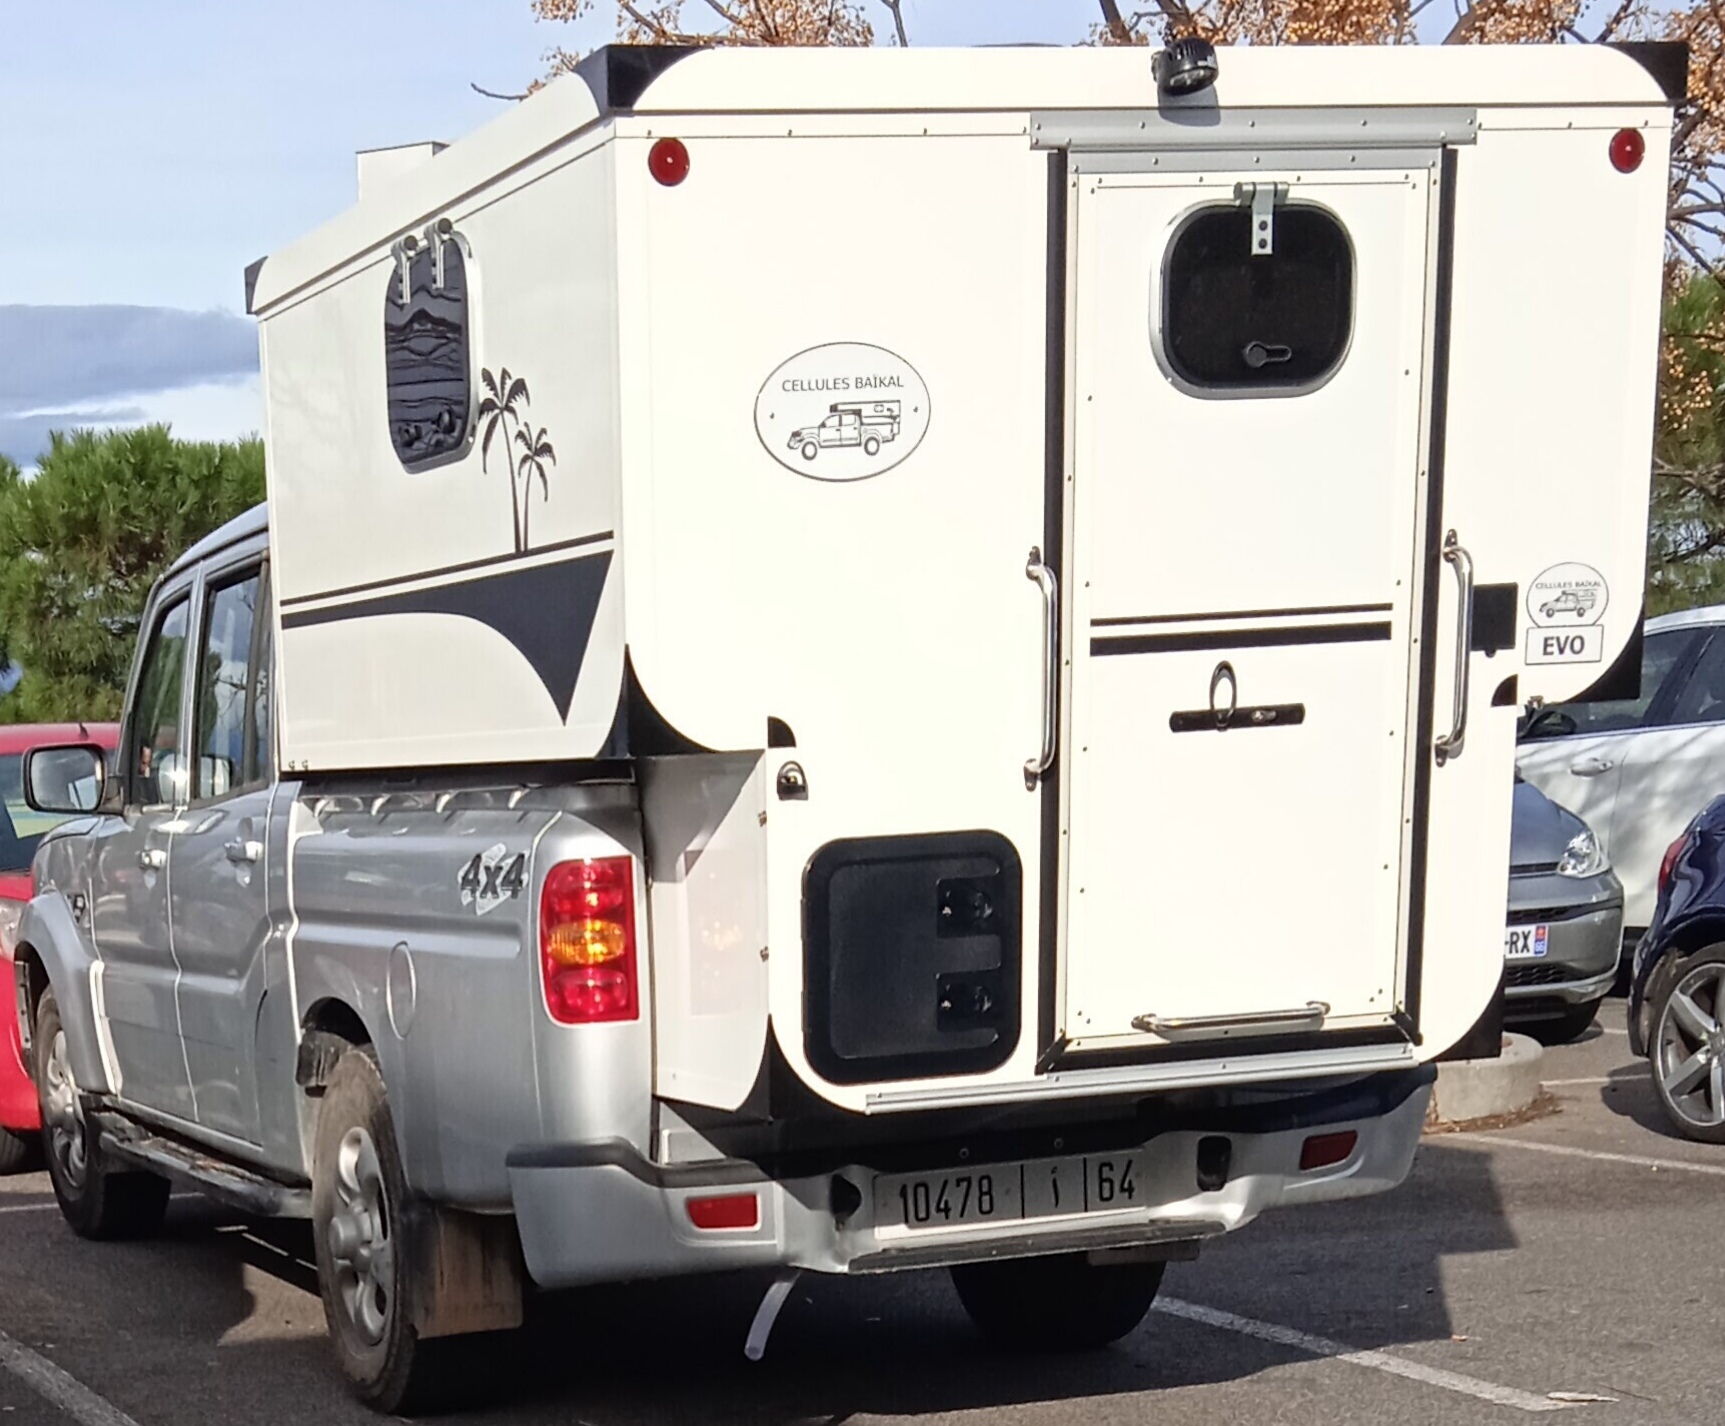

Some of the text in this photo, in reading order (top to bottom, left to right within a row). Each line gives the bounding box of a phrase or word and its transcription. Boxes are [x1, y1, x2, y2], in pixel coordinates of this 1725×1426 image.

[782, 374, 904, 392] CELLULES BAÏKAL
[1535, 582, 1573, 590] CELLULES
[1542, 635, 1585, 656] EVO
[900, 1174, 995, 1225] 10478
[1098, 1159, 1135, 1203] 64
